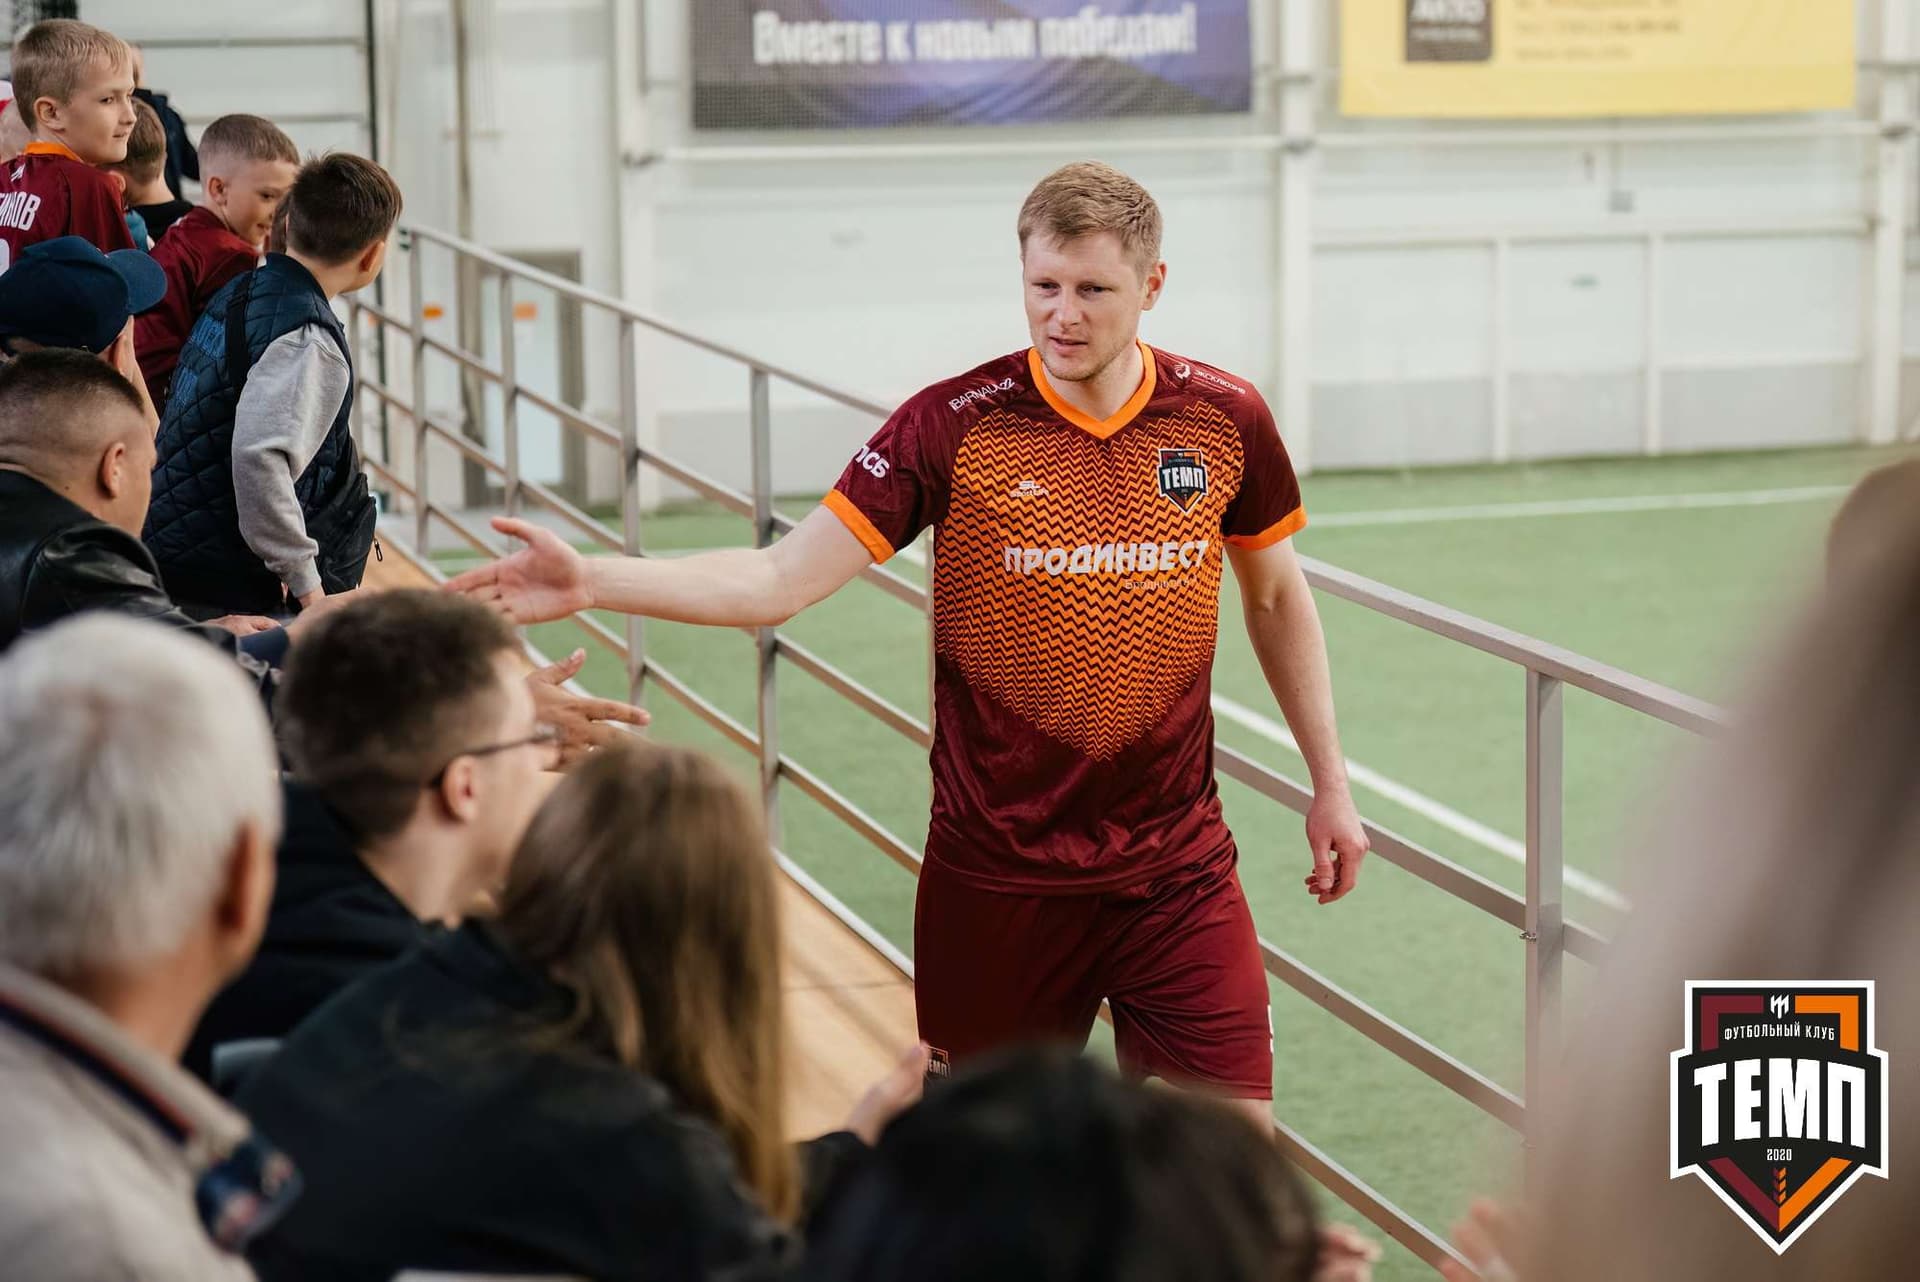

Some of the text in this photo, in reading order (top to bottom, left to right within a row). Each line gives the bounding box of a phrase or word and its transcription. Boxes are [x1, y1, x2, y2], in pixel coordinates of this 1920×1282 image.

[753, 10, 881, 65] Вместе
[1162, 466, 1204, 490] ТЕМП
[1004, 540, 1209, 576] ПРОДИНВЕСТ
